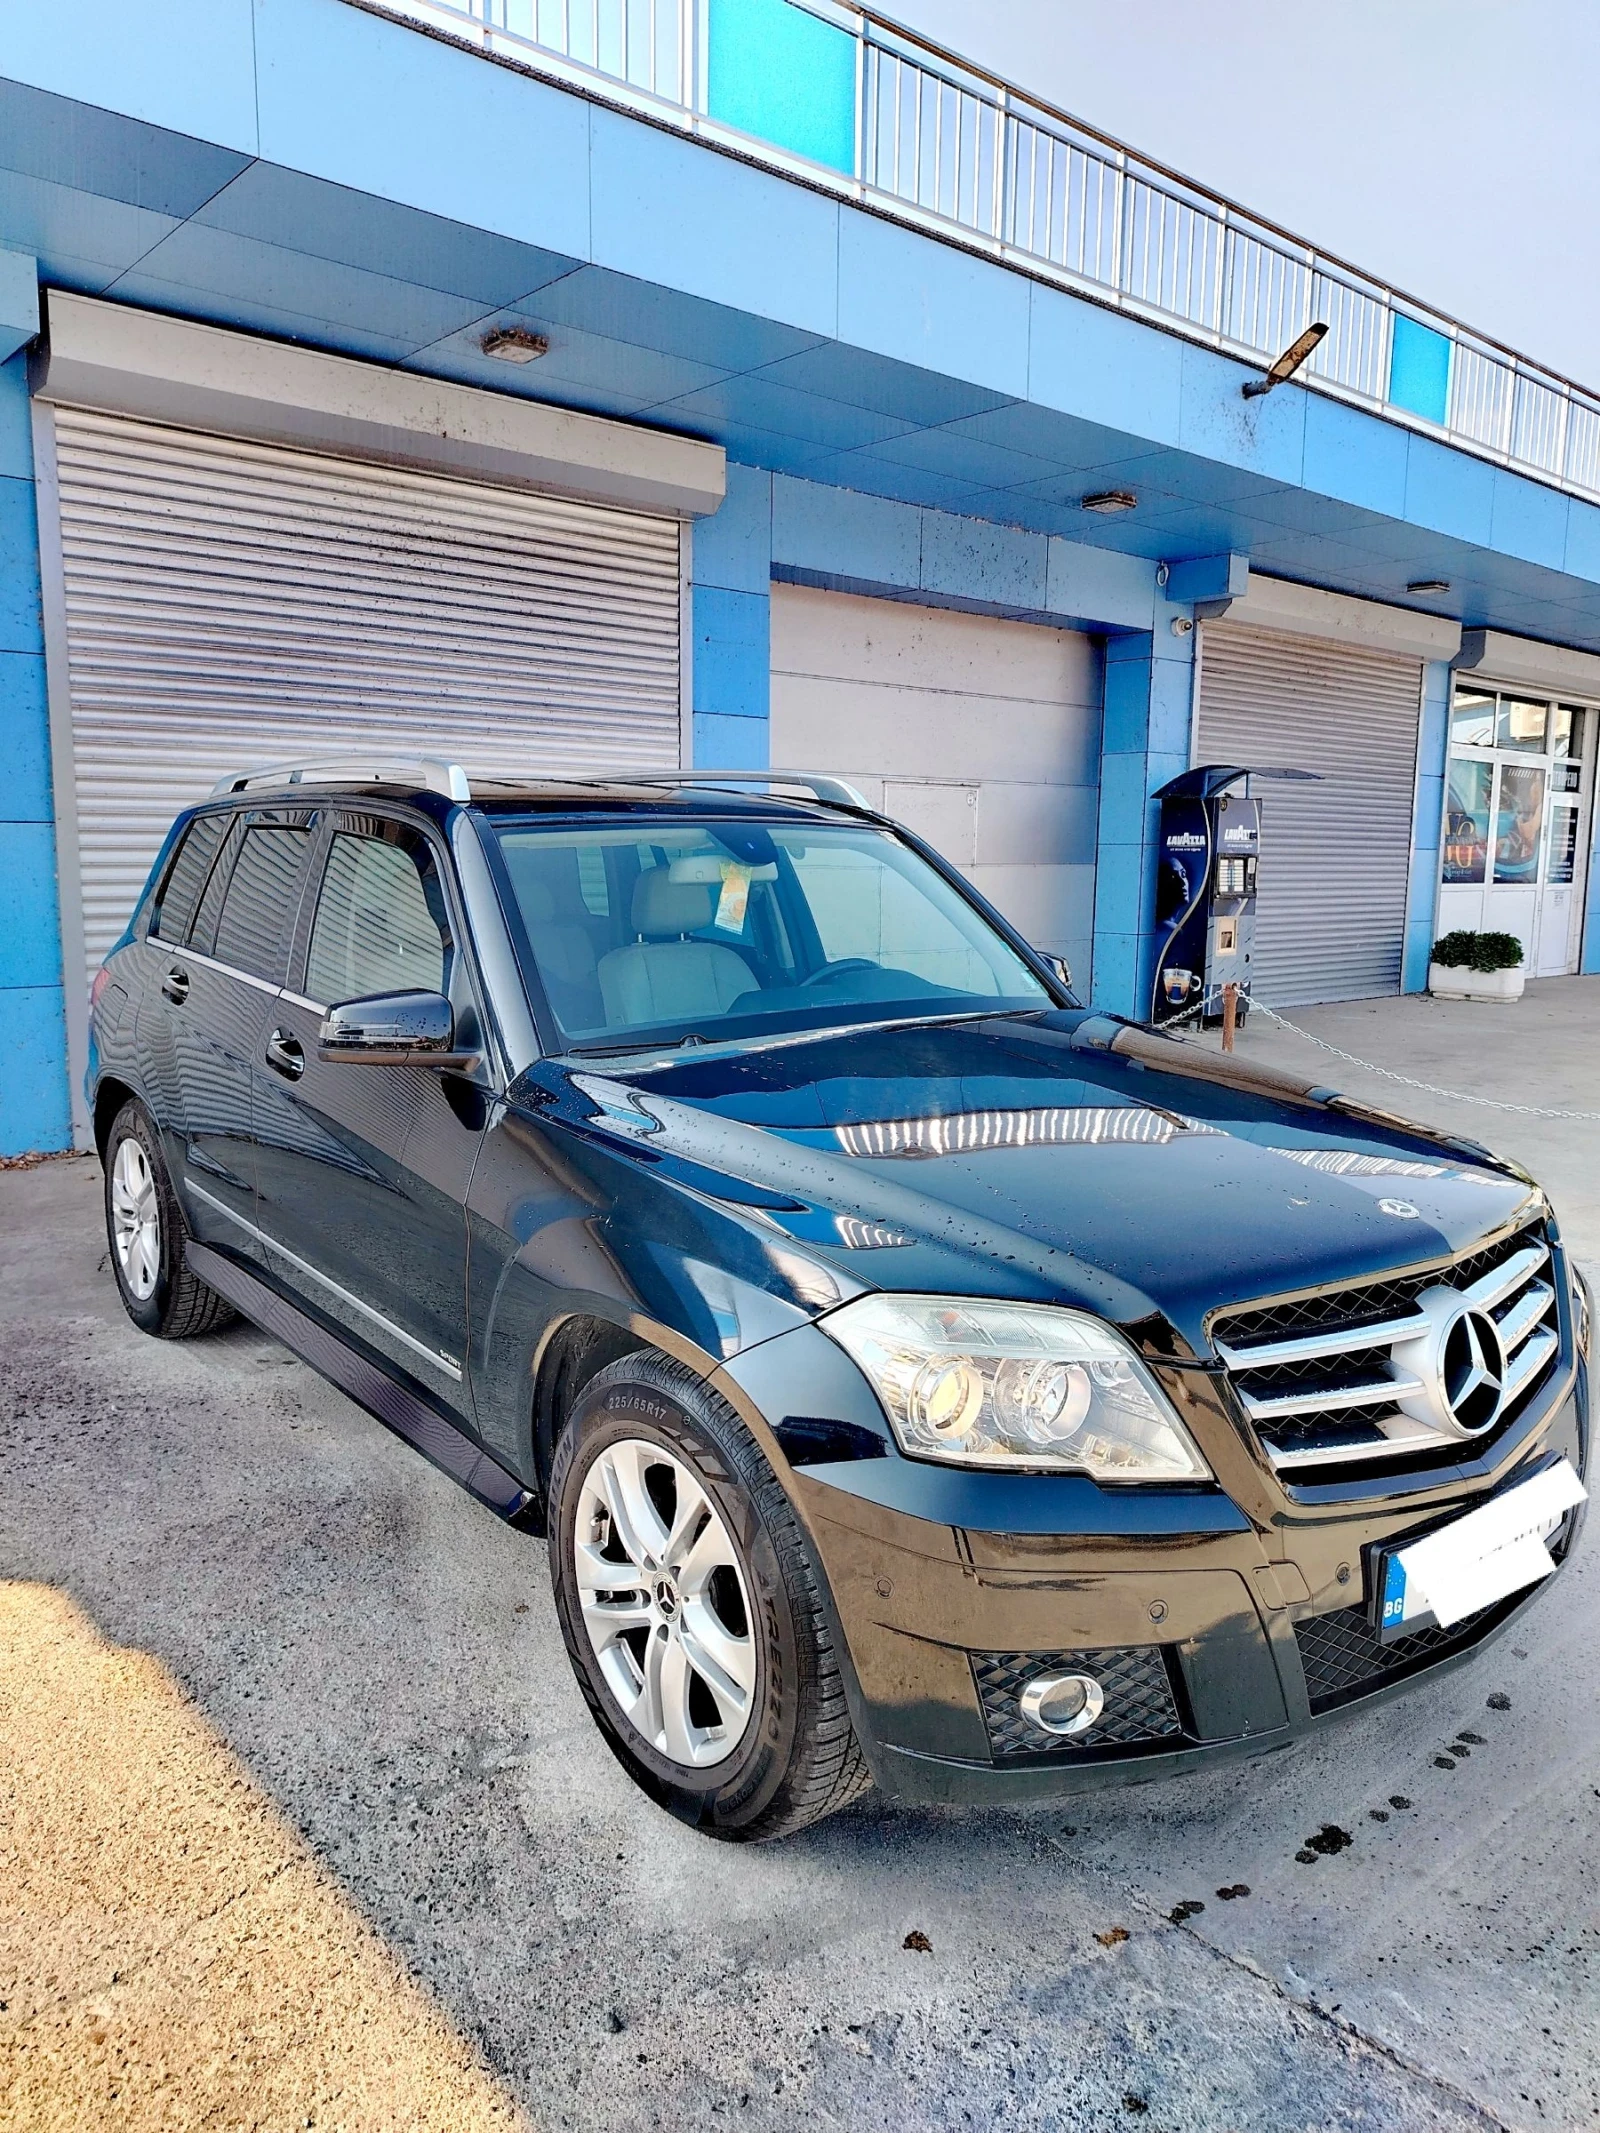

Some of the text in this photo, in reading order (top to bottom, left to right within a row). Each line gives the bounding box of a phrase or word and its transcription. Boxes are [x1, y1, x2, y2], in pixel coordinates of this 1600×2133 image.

[1166, 832, 1206, 846] LAVAZZA
[608, 1396, 667, 1420] 225/65R17
[548, 1434, 573, 1542] SAILUN
[1384, 1597, 1402, 1618] BG
[757, 1568, 783, 1742] ATREZZO
